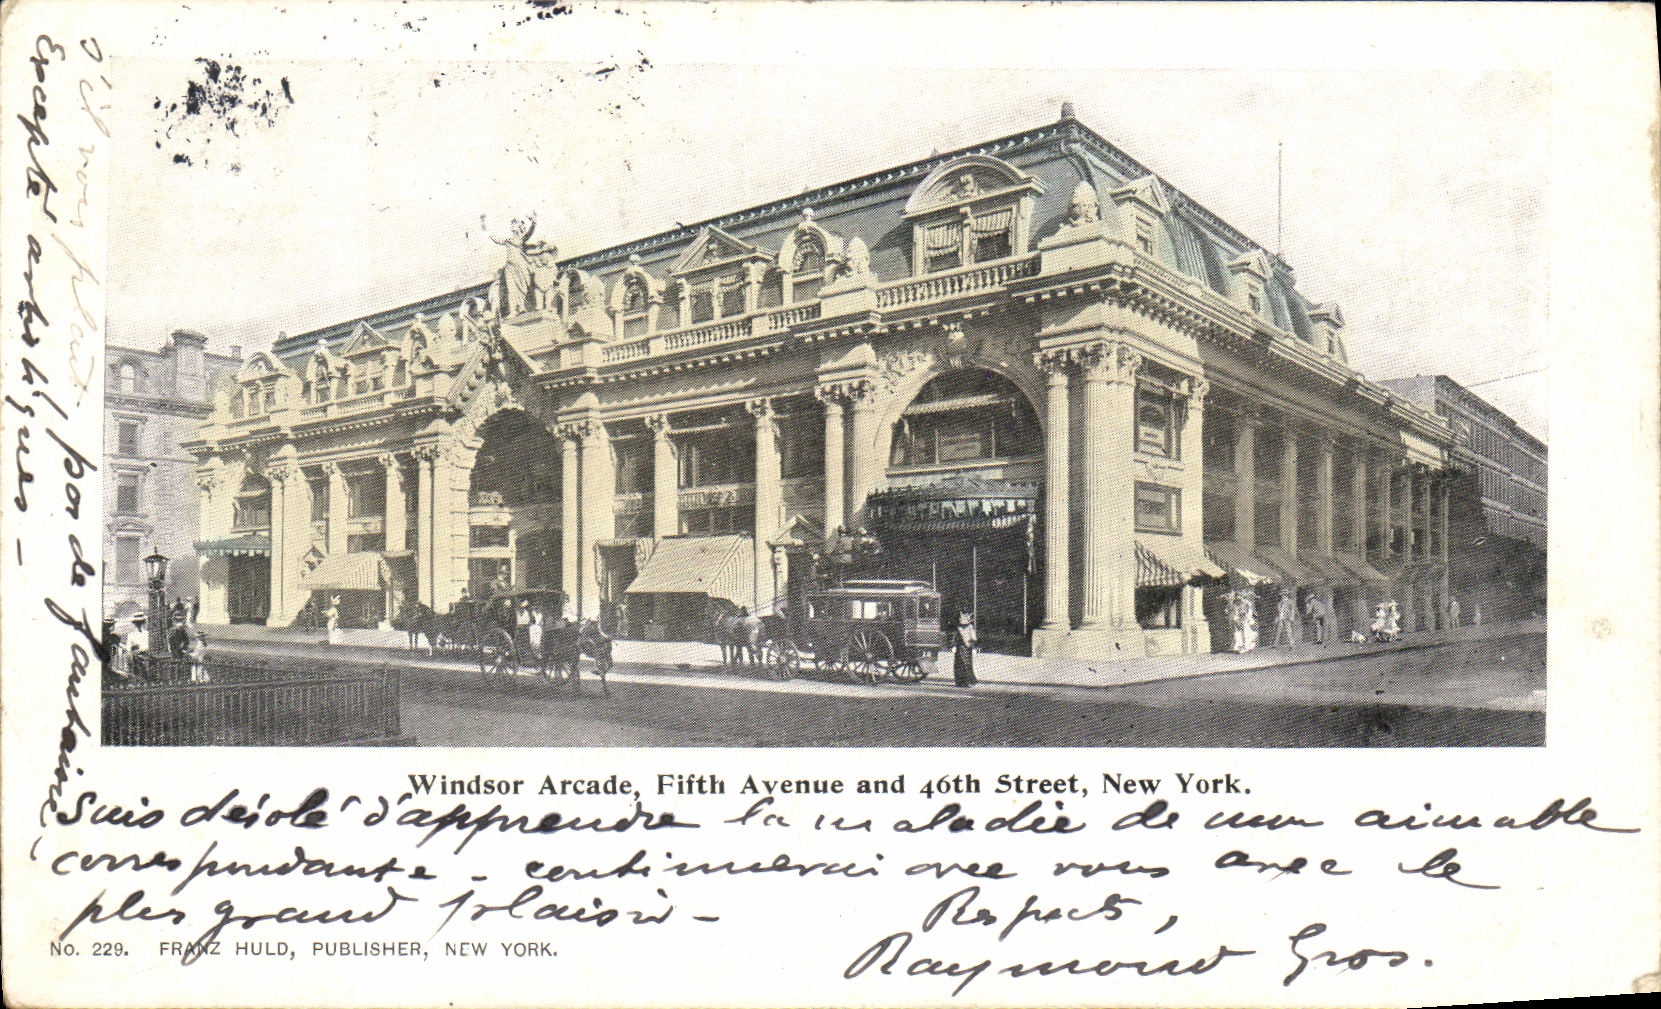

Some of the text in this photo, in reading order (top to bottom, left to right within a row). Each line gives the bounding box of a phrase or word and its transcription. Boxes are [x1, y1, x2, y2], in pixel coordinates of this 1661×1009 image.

[66, 534, 95, 588] de
[408, 773, 1253, 800] Windsor Arcade, Fifth Avenue and 46th Street, New York.
[56, 788, 165, 829] Suis
[724, 796, 791, 828] la
[1111, 799, 1180, 831] de
[1354, 796, 1642, 834] aimable
[1398, 848, 1501, 889] le
[49, 941, 559, 960] No. 229. FRANZ HULD, PUBLISHER, NEW YORK.
